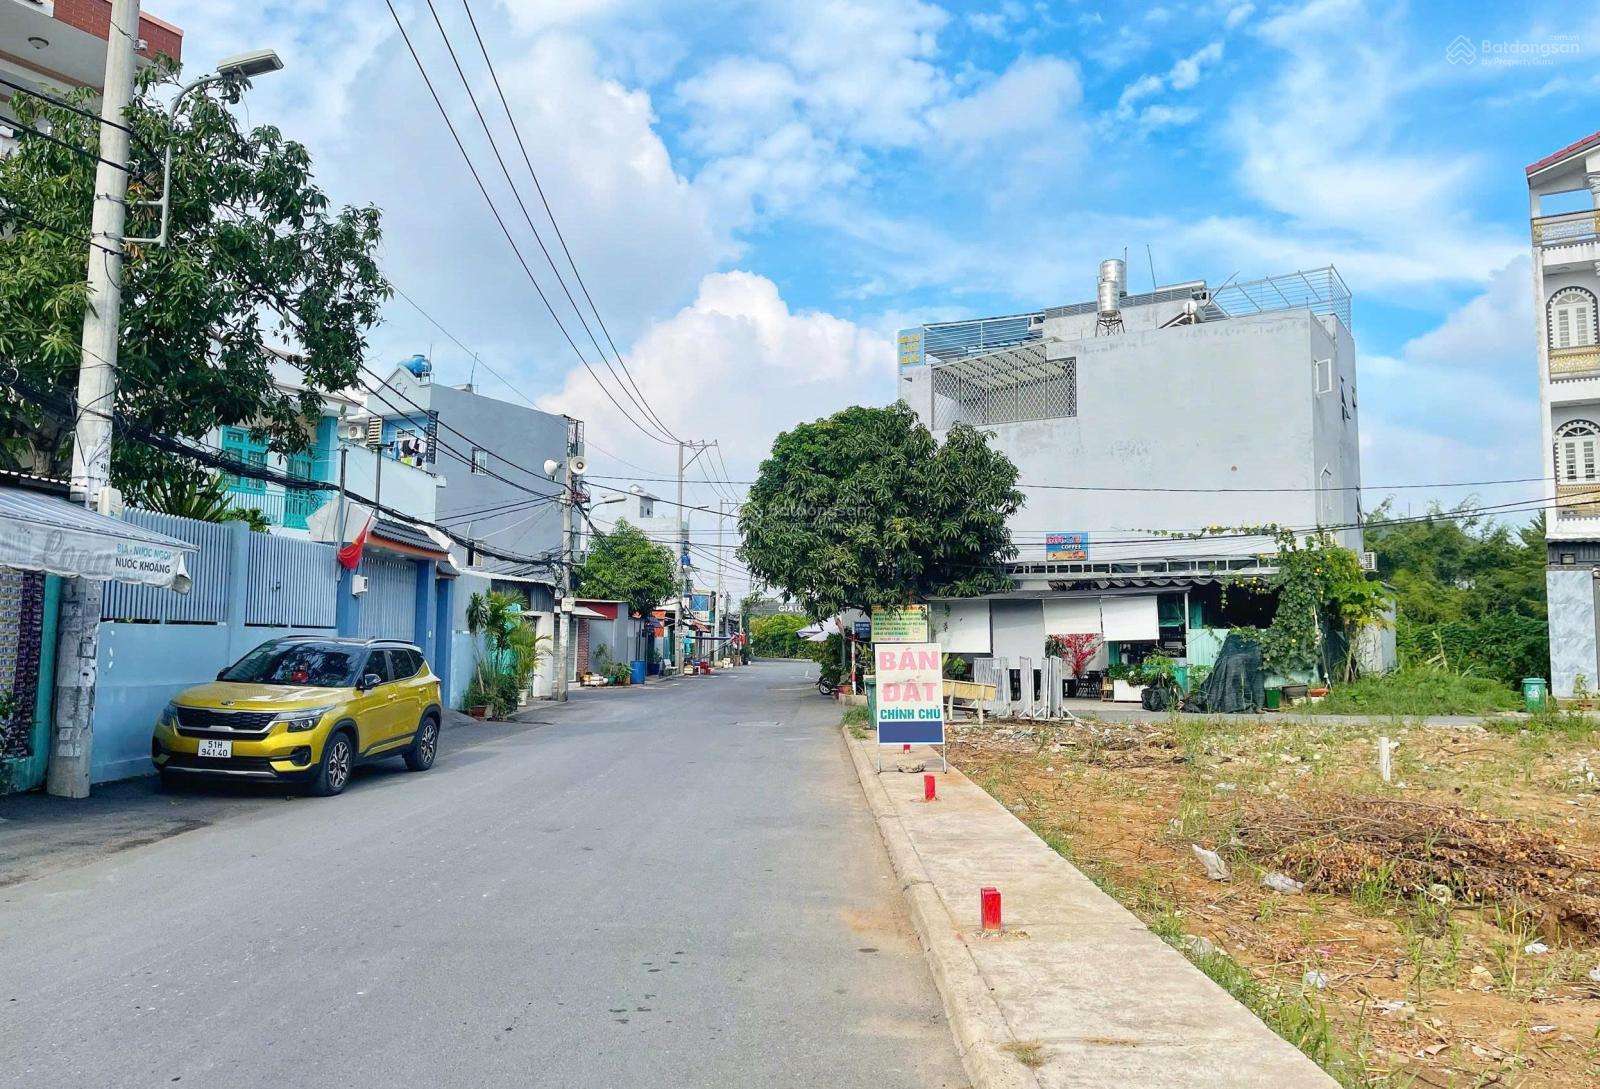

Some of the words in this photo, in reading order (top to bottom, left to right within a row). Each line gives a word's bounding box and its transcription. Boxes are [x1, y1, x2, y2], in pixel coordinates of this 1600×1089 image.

[139, 560, 171, 574] KHOÁNG
[879, 648, 938, 671] BÁN
[882, 675, 937, 702] ĐẤT
[880, 707, 915, 719] CHÍNH
[918, 706, 941, 719] CHỦ
[208, 741, 223, 749] 51H
[202, 749, 228, 757] 941.40
